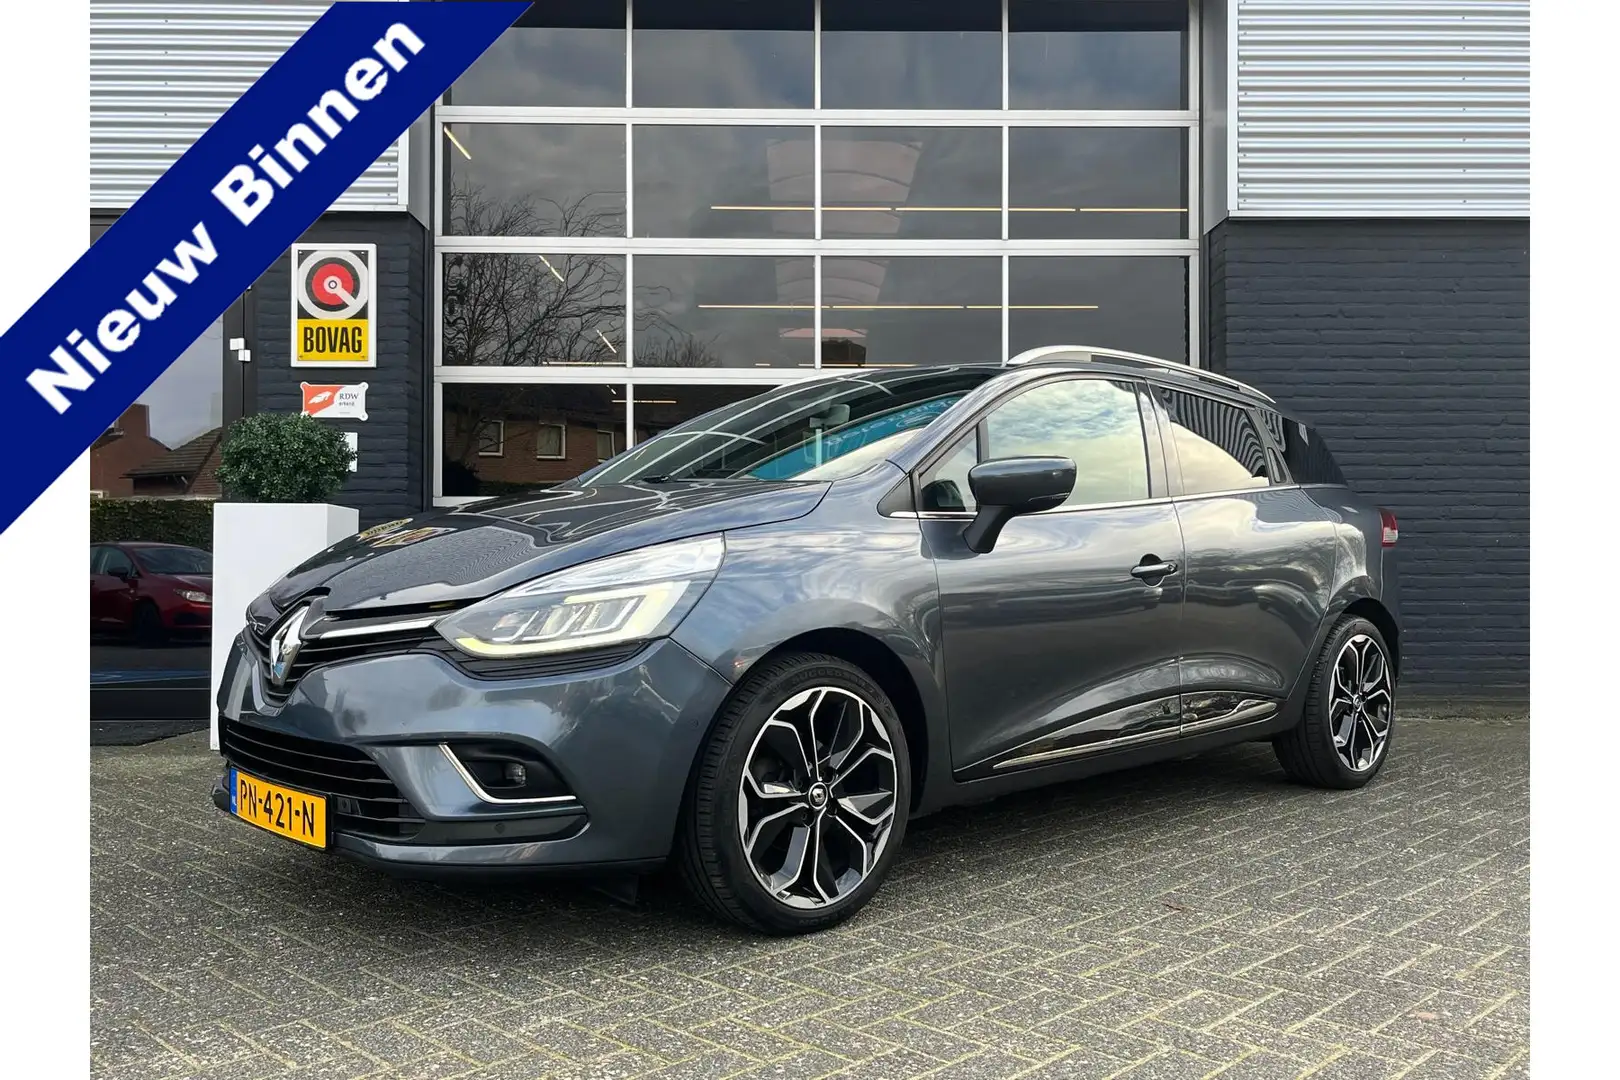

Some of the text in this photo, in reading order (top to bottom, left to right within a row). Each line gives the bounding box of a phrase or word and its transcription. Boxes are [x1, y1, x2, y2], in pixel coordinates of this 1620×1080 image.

[303, 326, 362, 353] BOVAG
[339, 392, 359, 400] RDW
[240, 779, 315, 838] PN-421-N
